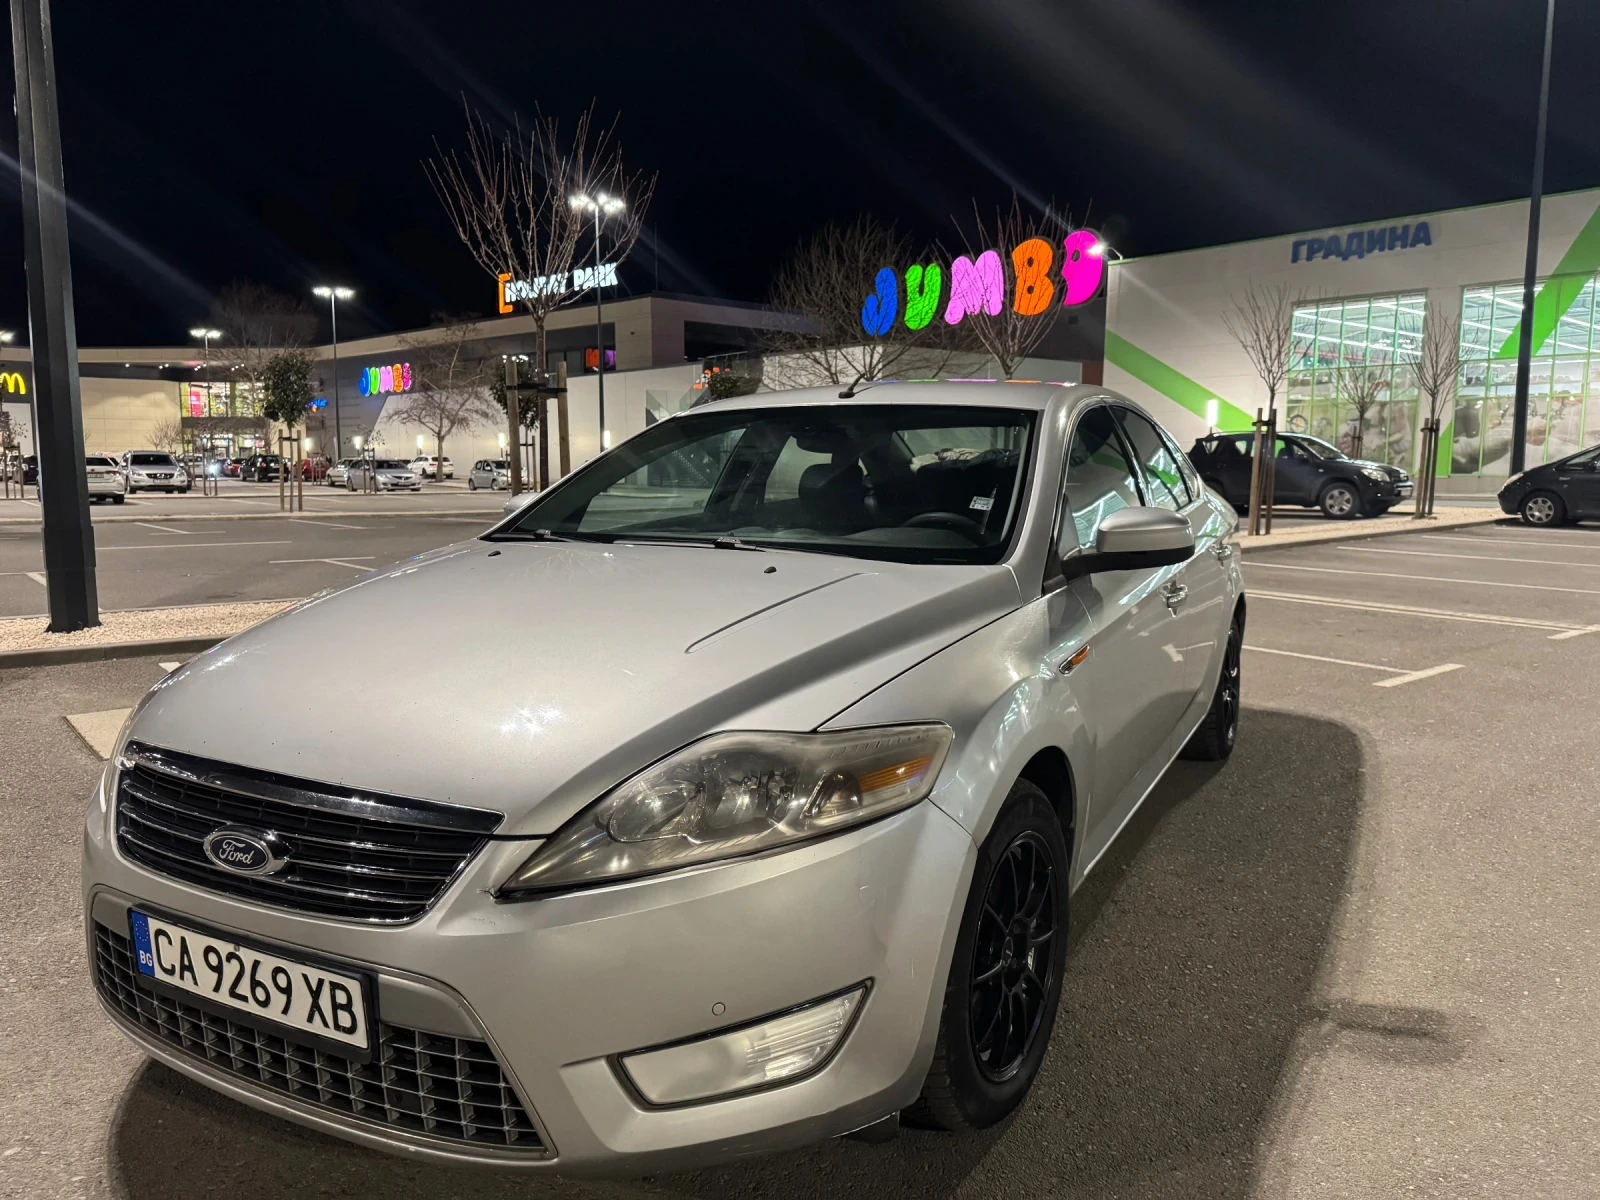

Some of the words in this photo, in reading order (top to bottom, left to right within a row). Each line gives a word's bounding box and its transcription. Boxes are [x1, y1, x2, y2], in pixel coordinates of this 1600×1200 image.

[1291, 221, 1432, 263] ГРАДИНА
[573, 262, 618, 291] PARK
[861, 230, 1103, 337] JUMBO
[359, 362, 412, 397] JUMBO
[218, 839, 255, 865] Ford
[139, 950, 153, 967] BG
[154, 928, 199, 987] CA
[203, 945, 293, 1016] 9269
[301, 972, 358, 1036] XB
